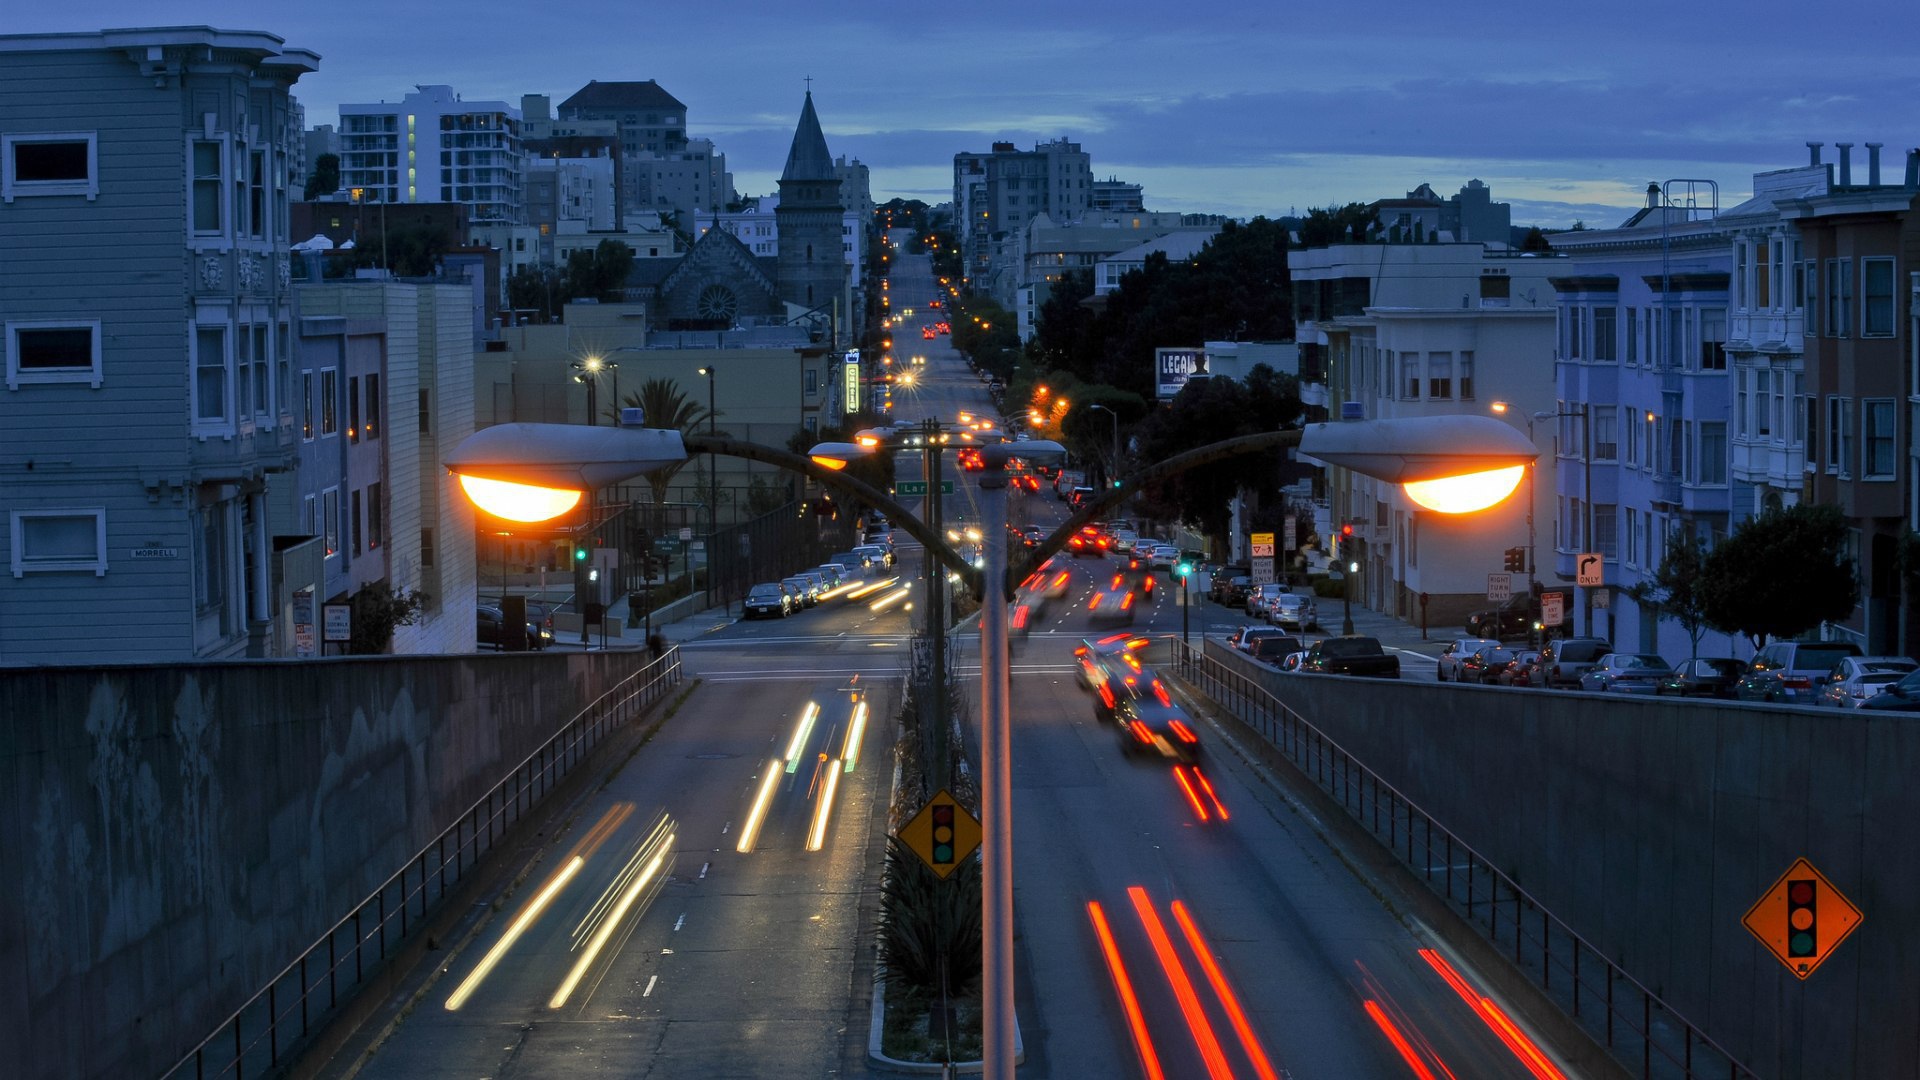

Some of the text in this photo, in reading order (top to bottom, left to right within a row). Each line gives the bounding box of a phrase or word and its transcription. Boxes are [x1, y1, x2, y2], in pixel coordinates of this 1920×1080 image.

[1162, 355, 1194, 373] LEGAL
[904, 485, 946, 493] Larn
[135, 549, 174, 557] MORRELL
[1580, 576, 1600, 584] ONLY
